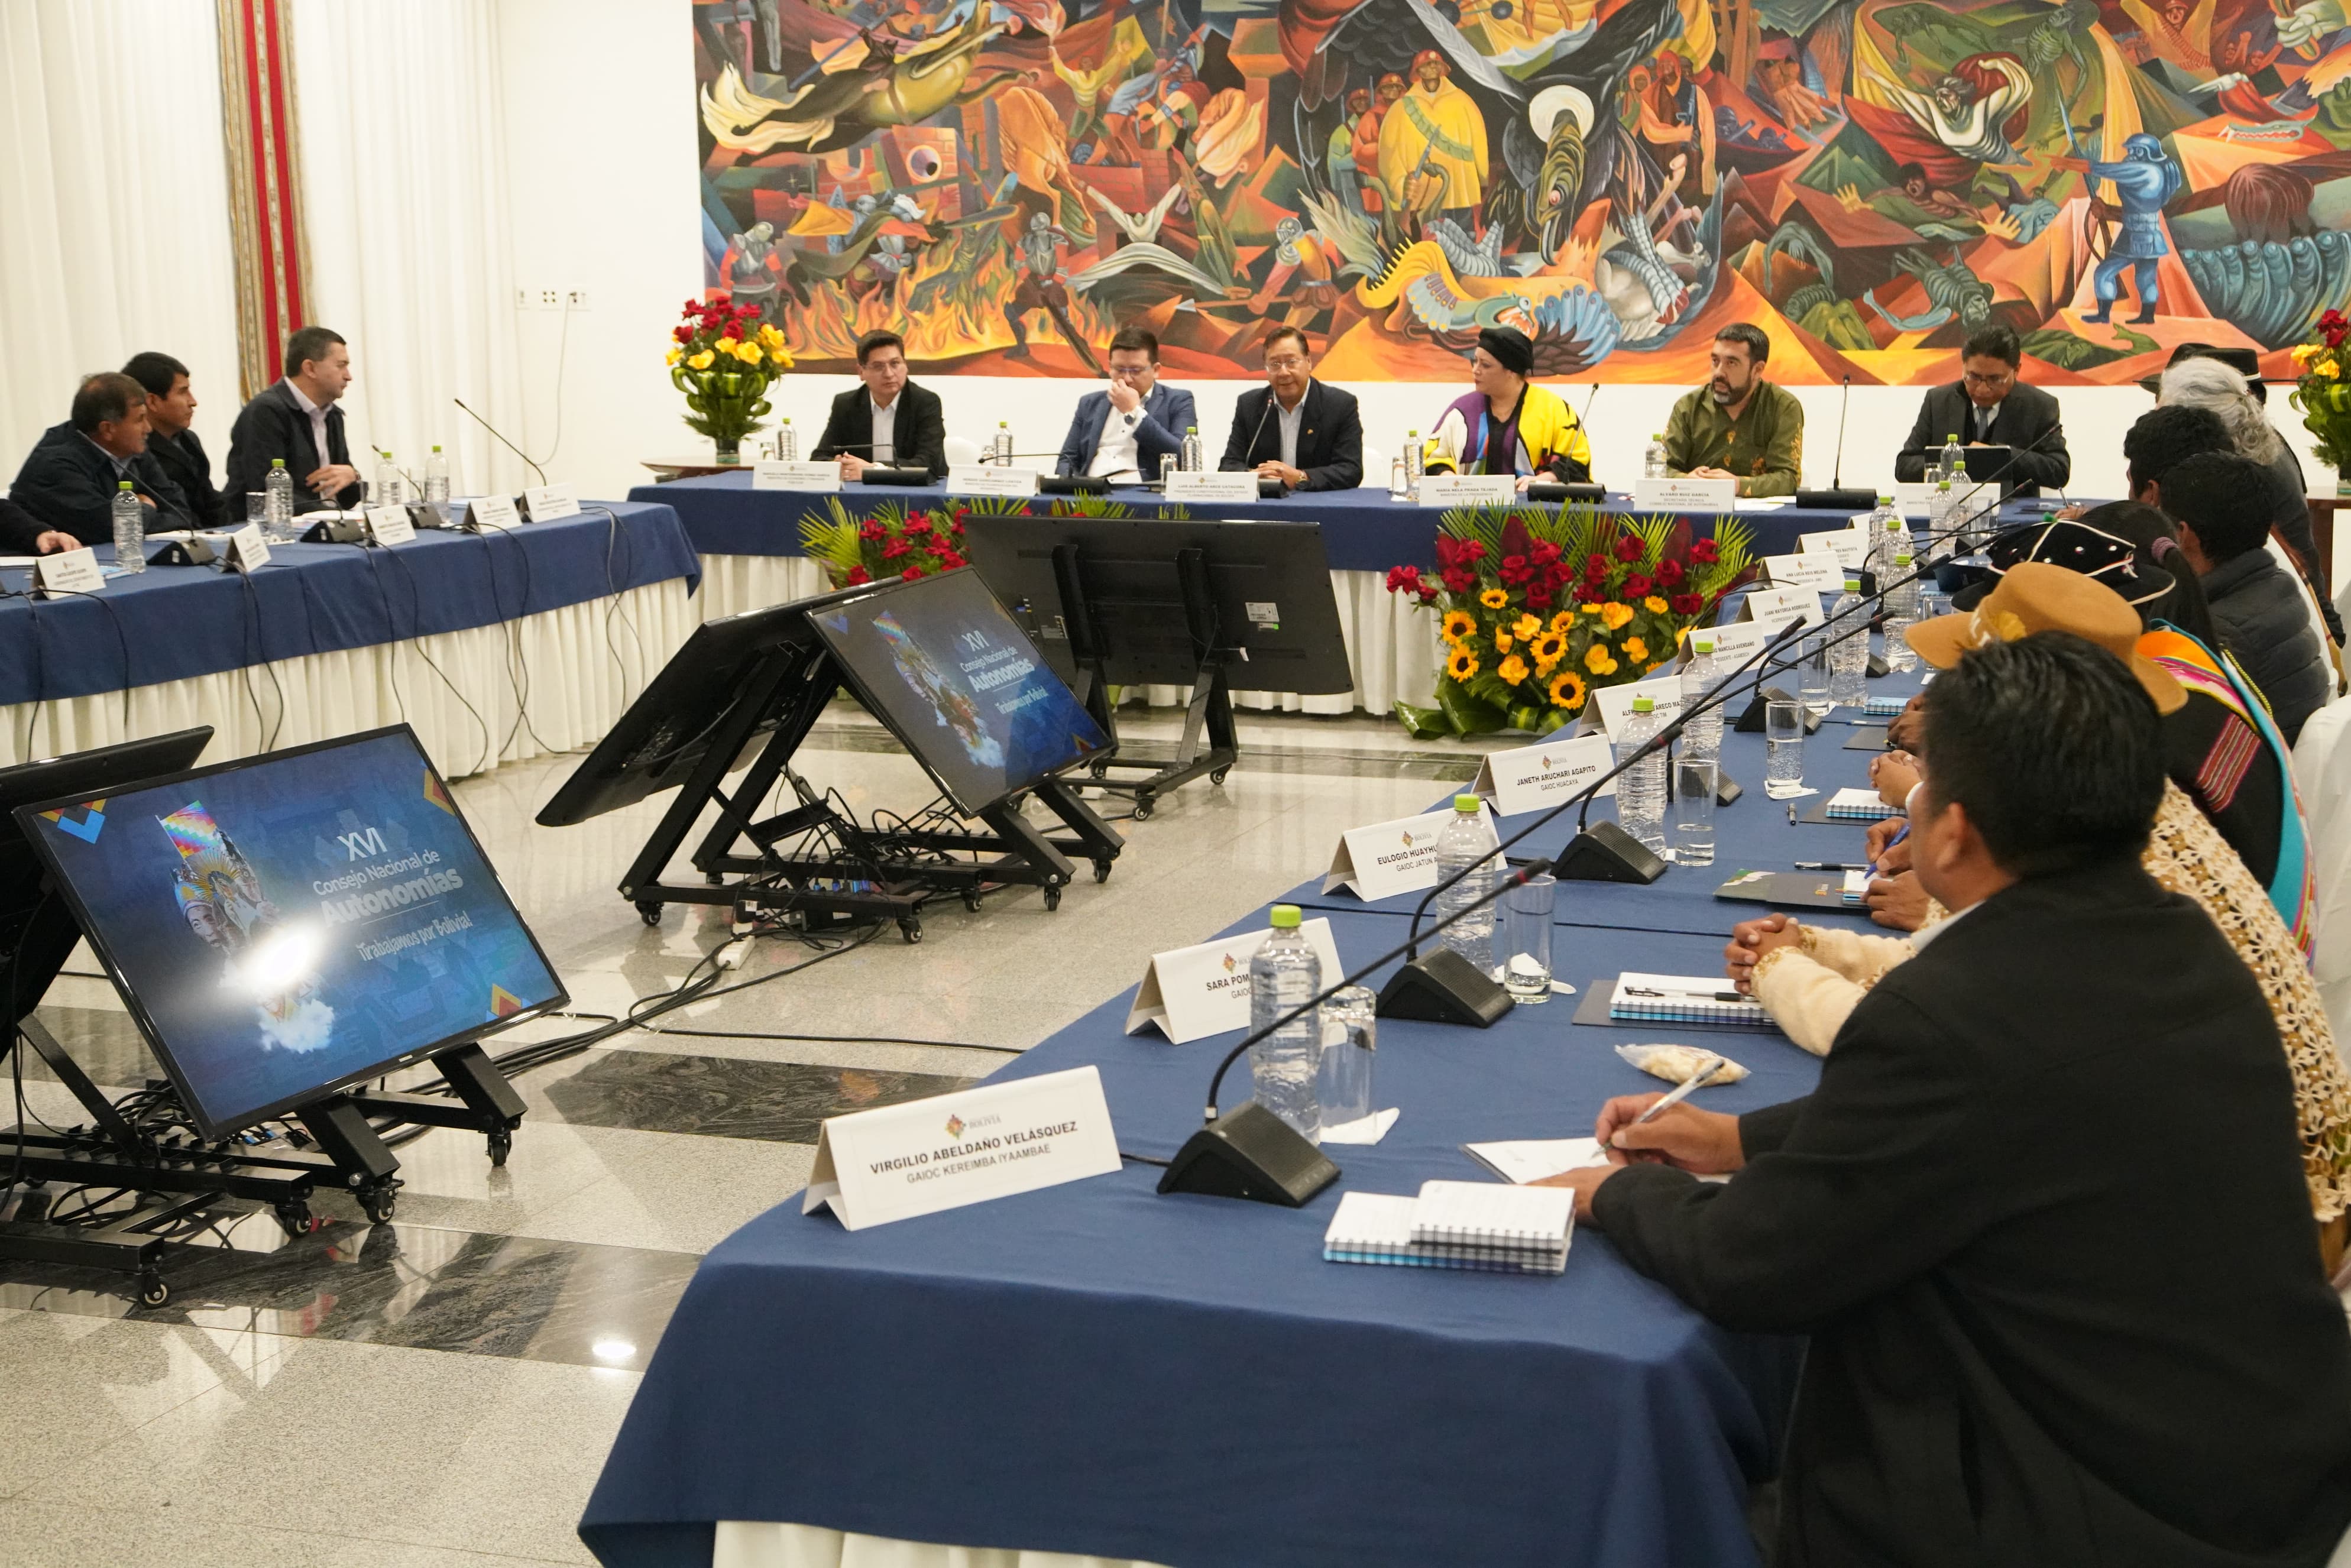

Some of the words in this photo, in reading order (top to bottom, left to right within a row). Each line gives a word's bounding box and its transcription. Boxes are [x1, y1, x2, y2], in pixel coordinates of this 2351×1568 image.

[961, 630, 989, 651] XVI
[960, 656, 986, 672] Consejo
[982, 647, 1011, 664] Nacional
[1007, 645, 1018, 656] de
[968, 657, 1035, 692] Autonomías
[1517, 776, 1540, 786] JANETH
[1541, 770, 1570, 781] ARUCHARI
[1572, 765, 1596, 776] AGAPITO
[1541, 782, 1556, 792] GAIOC
[1557, 779, 1579, 788] HUACAYA
[336, 827, 388, 861] XVI
[1377, 851, 1408, 865] EULOGIO
[1409, 844, 1438, 858] HUAYHU
[312, 870, 367, 896] Consejo
[365, 852, 421, 882] Nacional
[422, 849, 441, 865] de
[1396, 861, 1414, 872] GAIOC
[1416, 857, 1433, 867] JATUN
[321, 867, 464, 928] Autonomías
[417, 925, 436, 945] por
[1206, 979, 1230, 991] SARA
[1230, 973, 1251, 986] POM
[969, 1115, 1002, 1130] BOLIVIA
[870, 1154, 928, 1174] VIRGILIO
[933, 1136, 1000, 1161] ABELDAÑO
[1004, 1121, 1078, 1146] VELÁSQUEZ
[906, 1168, 941, 1184] GAIOC
[943, 1156, 997, 1177] KEREIMBA
[999, 1143, 1051, 1167] IYAAMBAE
